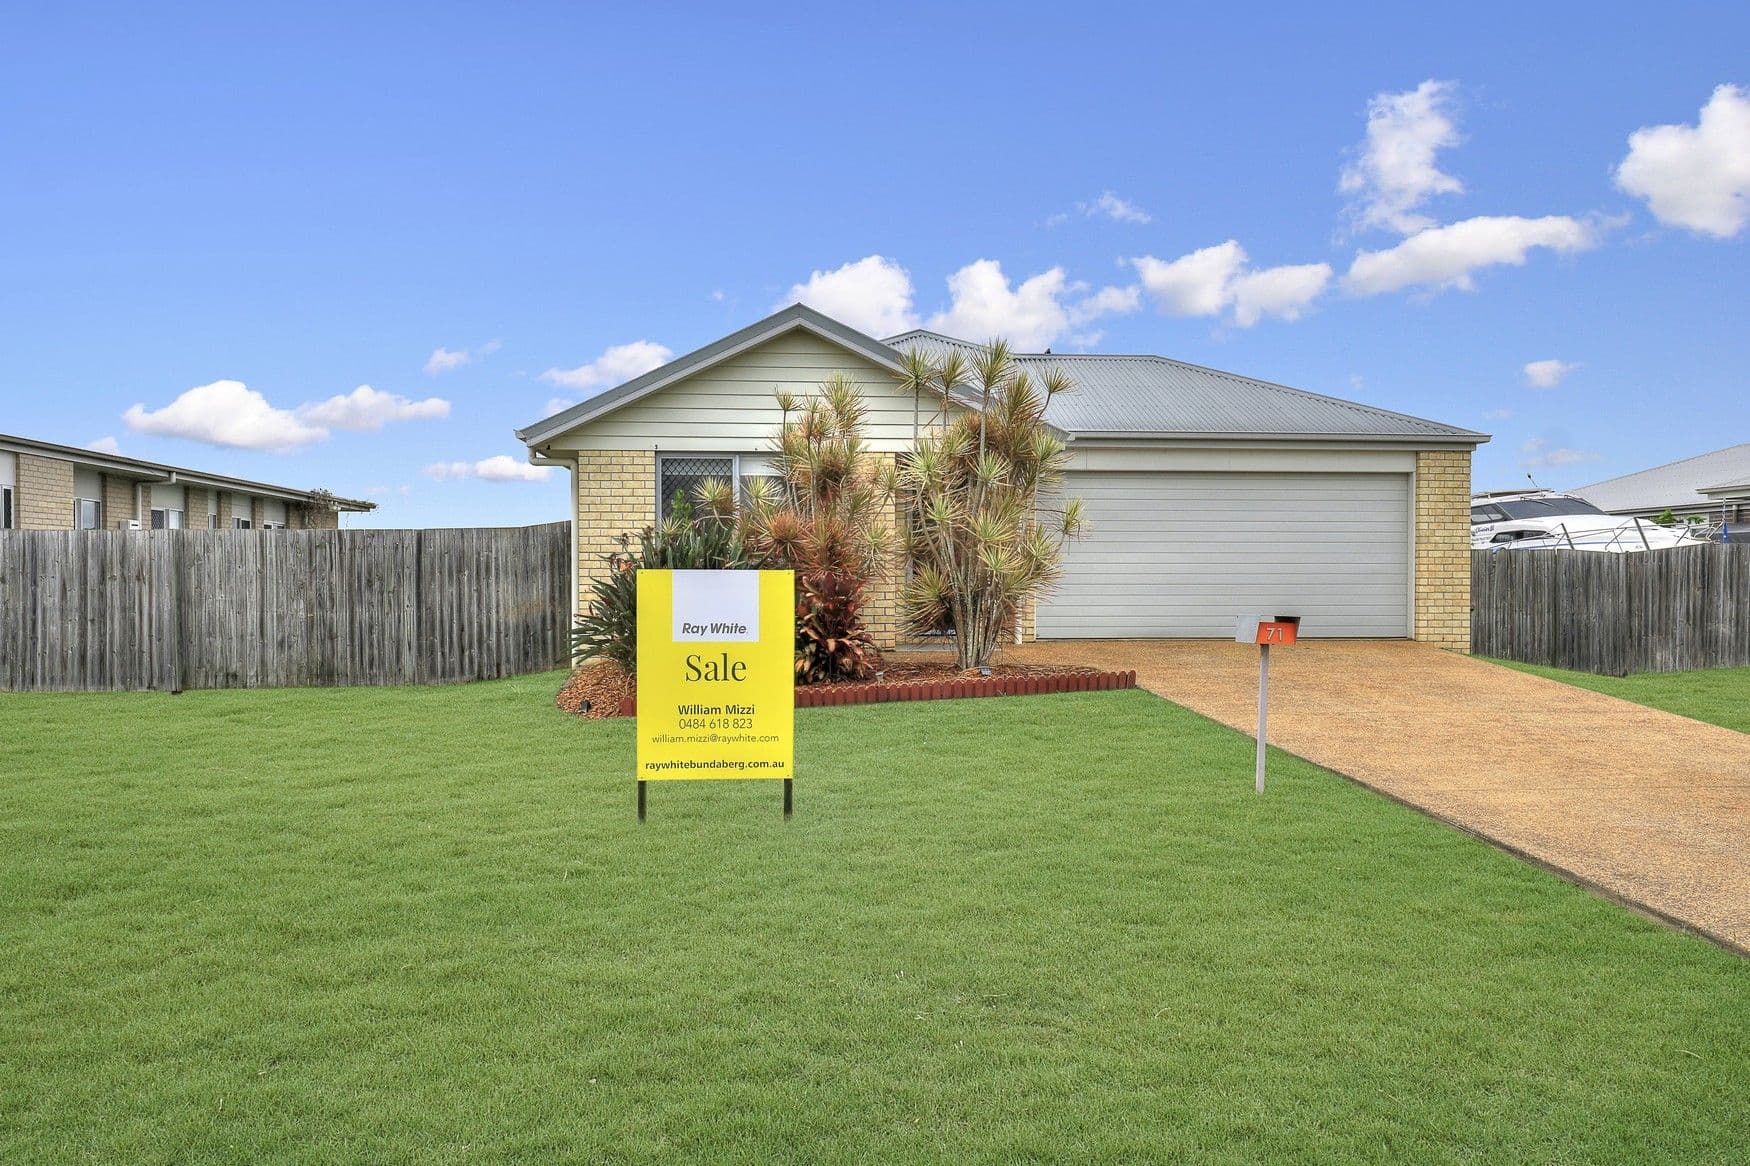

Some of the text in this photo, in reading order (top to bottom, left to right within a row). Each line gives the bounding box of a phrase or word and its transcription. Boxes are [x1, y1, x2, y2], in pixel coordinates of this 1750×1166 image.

[682, 622, 747, 637] Ray White
[1266, 627, 1282, 641] 71
[685, 652, 747, 682] Sale
[678, 704, 755, 715] William Mizzi
[678, 718, 753, 730] 0484 618 823
[651, 733, 780, 745] william.mizzi@raywhite.com
[645, 759, 785, 771] raywhitebundaberg.com.au
